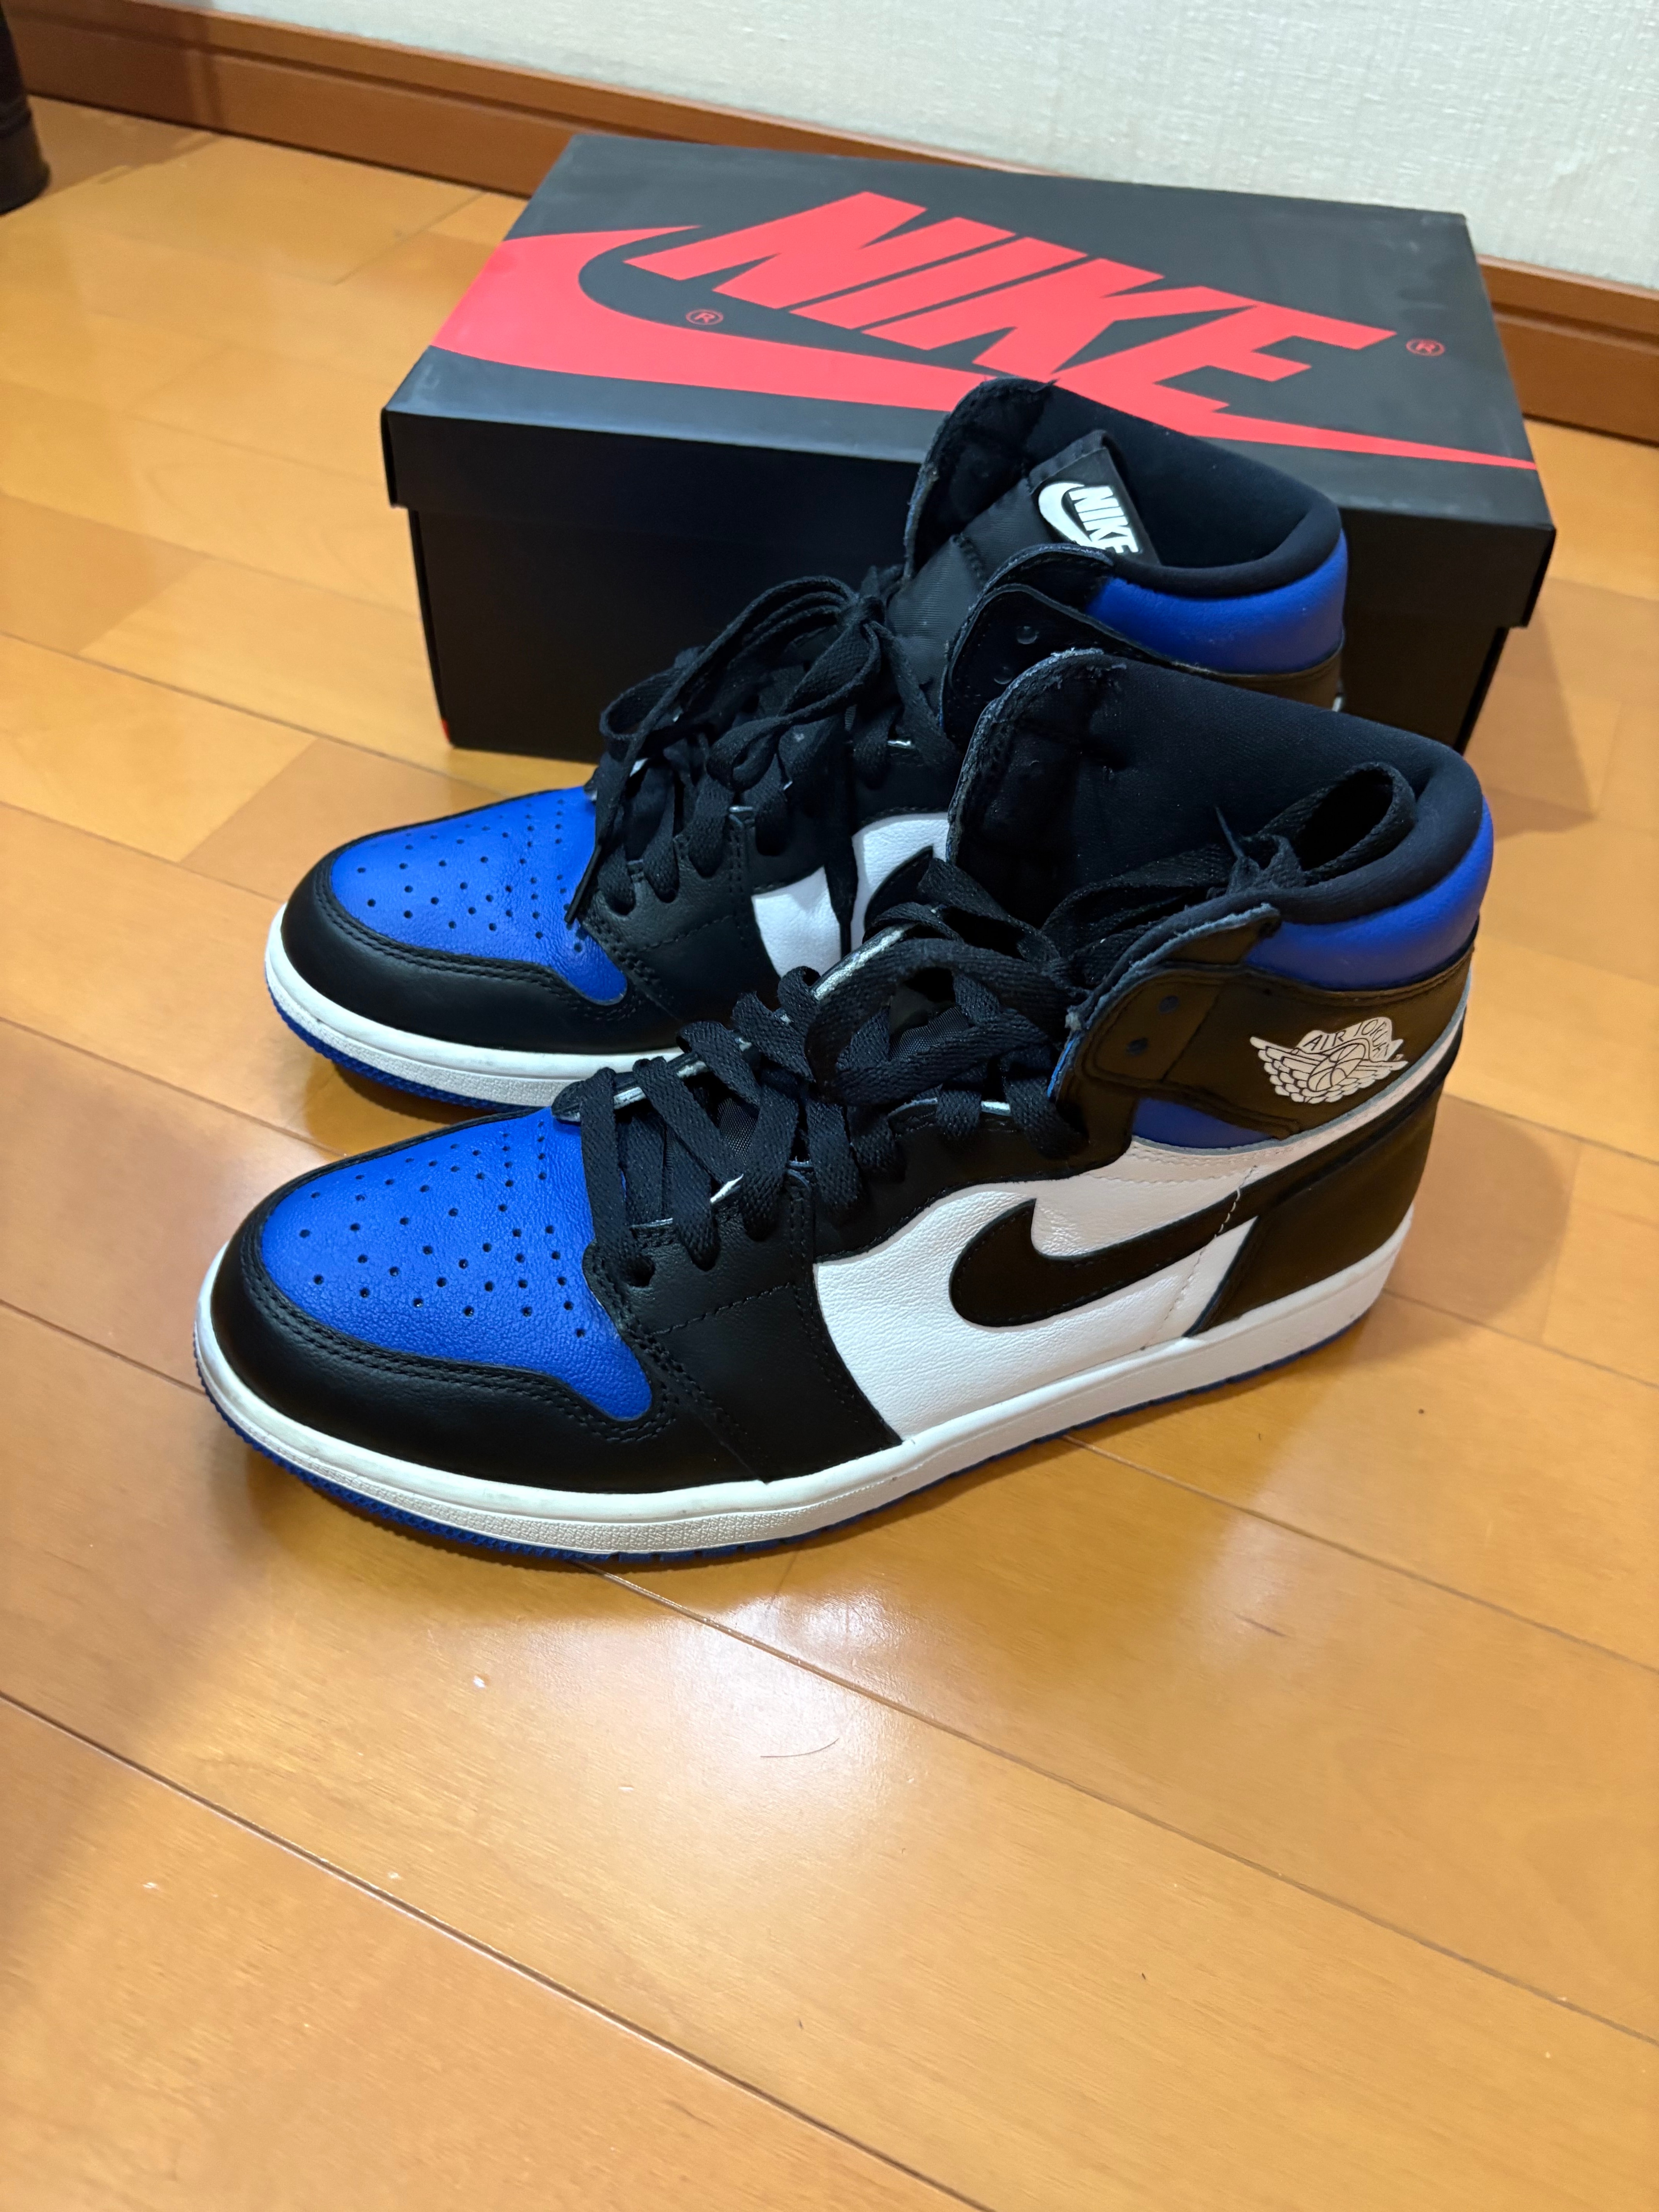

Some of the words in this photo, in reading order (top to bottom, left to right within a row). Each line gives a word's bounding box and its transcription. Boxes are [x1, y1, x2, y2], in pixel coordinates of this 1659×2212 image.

[623, 191, 1398, 415] NIKE
[1068, 485, 1139, 553] NIKE
[1303, 1030, 1346, 1051] AIR
